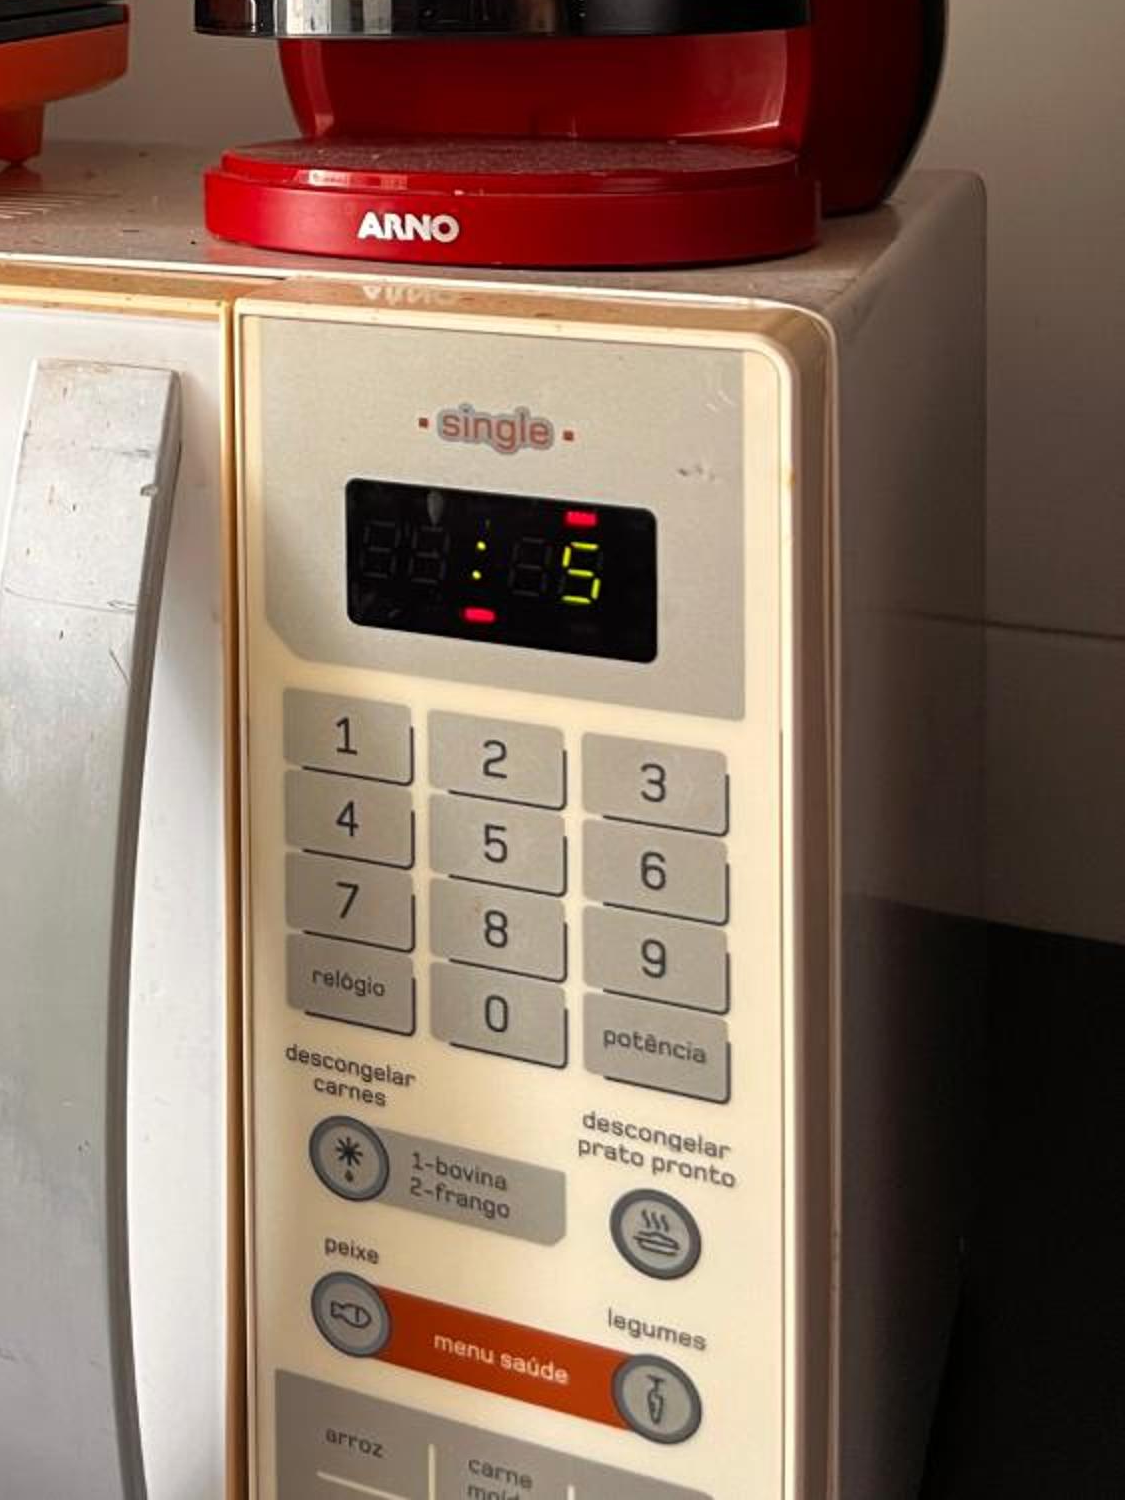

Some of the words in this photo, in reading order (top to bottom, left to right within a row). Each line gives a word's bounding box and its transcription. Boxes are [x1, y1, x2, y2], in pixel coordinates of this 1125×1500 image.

[357, 211, 460, 243] ARNO
[439, 404, 553, 451] single
[336, 717, 358, 755] 1
[482, 739, 507, 779] 2
[640, 763, 667, 803] 3
[336, 801, 359, 837] 4
[484, 824, 508, 863] 5
[640, 851, 667, 891] 6
[336, 882, 359, 919] 7
[484, 910, 508, 948] 8
[641, 939, 667, 979] 9
[312, 967, 386, 997] relógio
[485, 995, 508, 1033] 0
[285, 1044, 416, 1087] descongelar
[603, 1028, 707, 1065] potência
[314, 1077, 386, 1107] carnes
[582, 1111, 731, 1159] descongelar
[412, 1151, 507, 1191] 1-bovina
[578, 1139, 644, 1167] prato
[652, 1155, 736, 1188] pronto
[410, 1176, 510, 1219] 2-frango
[324, 1235, 379, 1265] peixe
[607, 1307, 707, 1352] legumes
[433, 1333, 495, 1365] menu
[500, 1347, 569, 1385] saúde
[325, 1427, 384, 1459] arroz
[468, 1459, 532, 1491] carne
